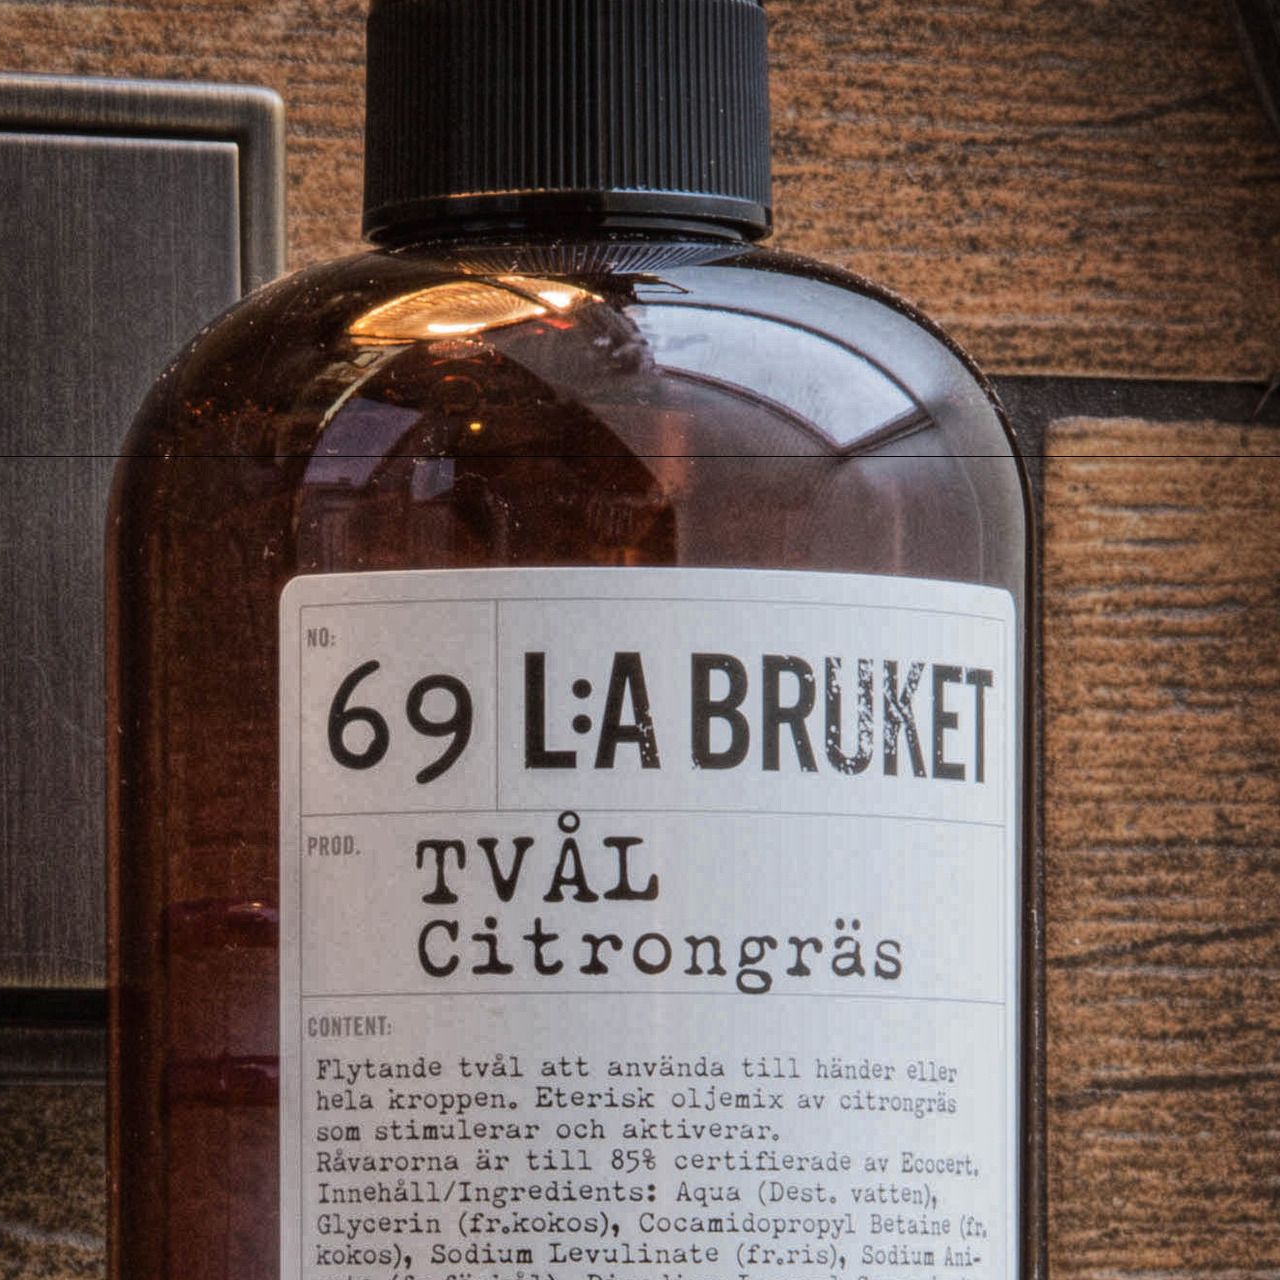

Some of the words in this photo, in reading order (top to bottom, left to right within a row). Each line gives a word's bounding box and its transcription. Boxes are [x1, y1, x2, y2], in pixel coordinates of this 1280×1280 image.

[306, 627, 337, 648] NO:
[327, 659, 473, 784] 69
[524, 651, 661, 771] L:A
[690, 653, 993, 784] BRUKET
[308, 836, 361, 857] PROD.
[417, 810, 659, 904] TVÅL
[418, 917, 904, 993] Citrongräs
[307, 1016, 392, 1037] CONTENT:
[316, 1056, 442, 1085] Flytande
[460, 1053, 524, 1078] tvål
[541, 1057, 589, 1077] att
[607, 1056, 725, 1077] använda
[742, 1058, 800, 1078] till
[817, 1058, 895, 1081] händer
[907, 1058, 957, 1083] eller
[316, 1089, 374, 1111] hela
[388, 1088, 518, 1114] kroppen.
[536, 1086, 655, 1108] Eterisk
[672, 1088, 783, 1110] oljemix
[797, 1093, 825, 1110] av
[840, 1091, 957, 1118] citrongräs
[316, 1123, 361, 1141] som
[375, 1120, 540, 1141] stimulerar
[556, 1119, 605, 1140] och
[623, 1119, 780, 1141] aktiverar.
[316, 1150, 459, 1173] Råvarorna
[476, 1149, 509, 1170] är
[526, 1150, 592, 1170] till
[611, 1149, 656, 1172] 85%
[674, 1151, 851, 1172] certifierade
[864, 1158, 889, 1172] av
[901, 1152, 979, 1177] Ecocert.
[319, 1178, 656, 1208] Innehåll/Ingredients:
[677, 1182, 741, 1210] Aqua
[758, 1180, 837, 1206] (Dest.
[851, 1183, 937, 1209] vatten),
[317, 1212, 442, 1239] Glycerin
[458, 1211, 620, 1238] (fr.kokos),
[640, 1211, 856, 1238] Cocamidopropyl
[870, 1213, 951, 1235] Betaine
[960, 1214, 987, 1239] (fr.
[316, 1244, 412, 1269] kokos),
[430, 1243, 533, 1265] Sodium
[550, 1243, 719, 1264] Levulinate
[736, 1244, 847, 1269] (fr.ris),
[862, 1246, 935, 1266] Sodium
[945, 1246, 981, 1267] Ani-
